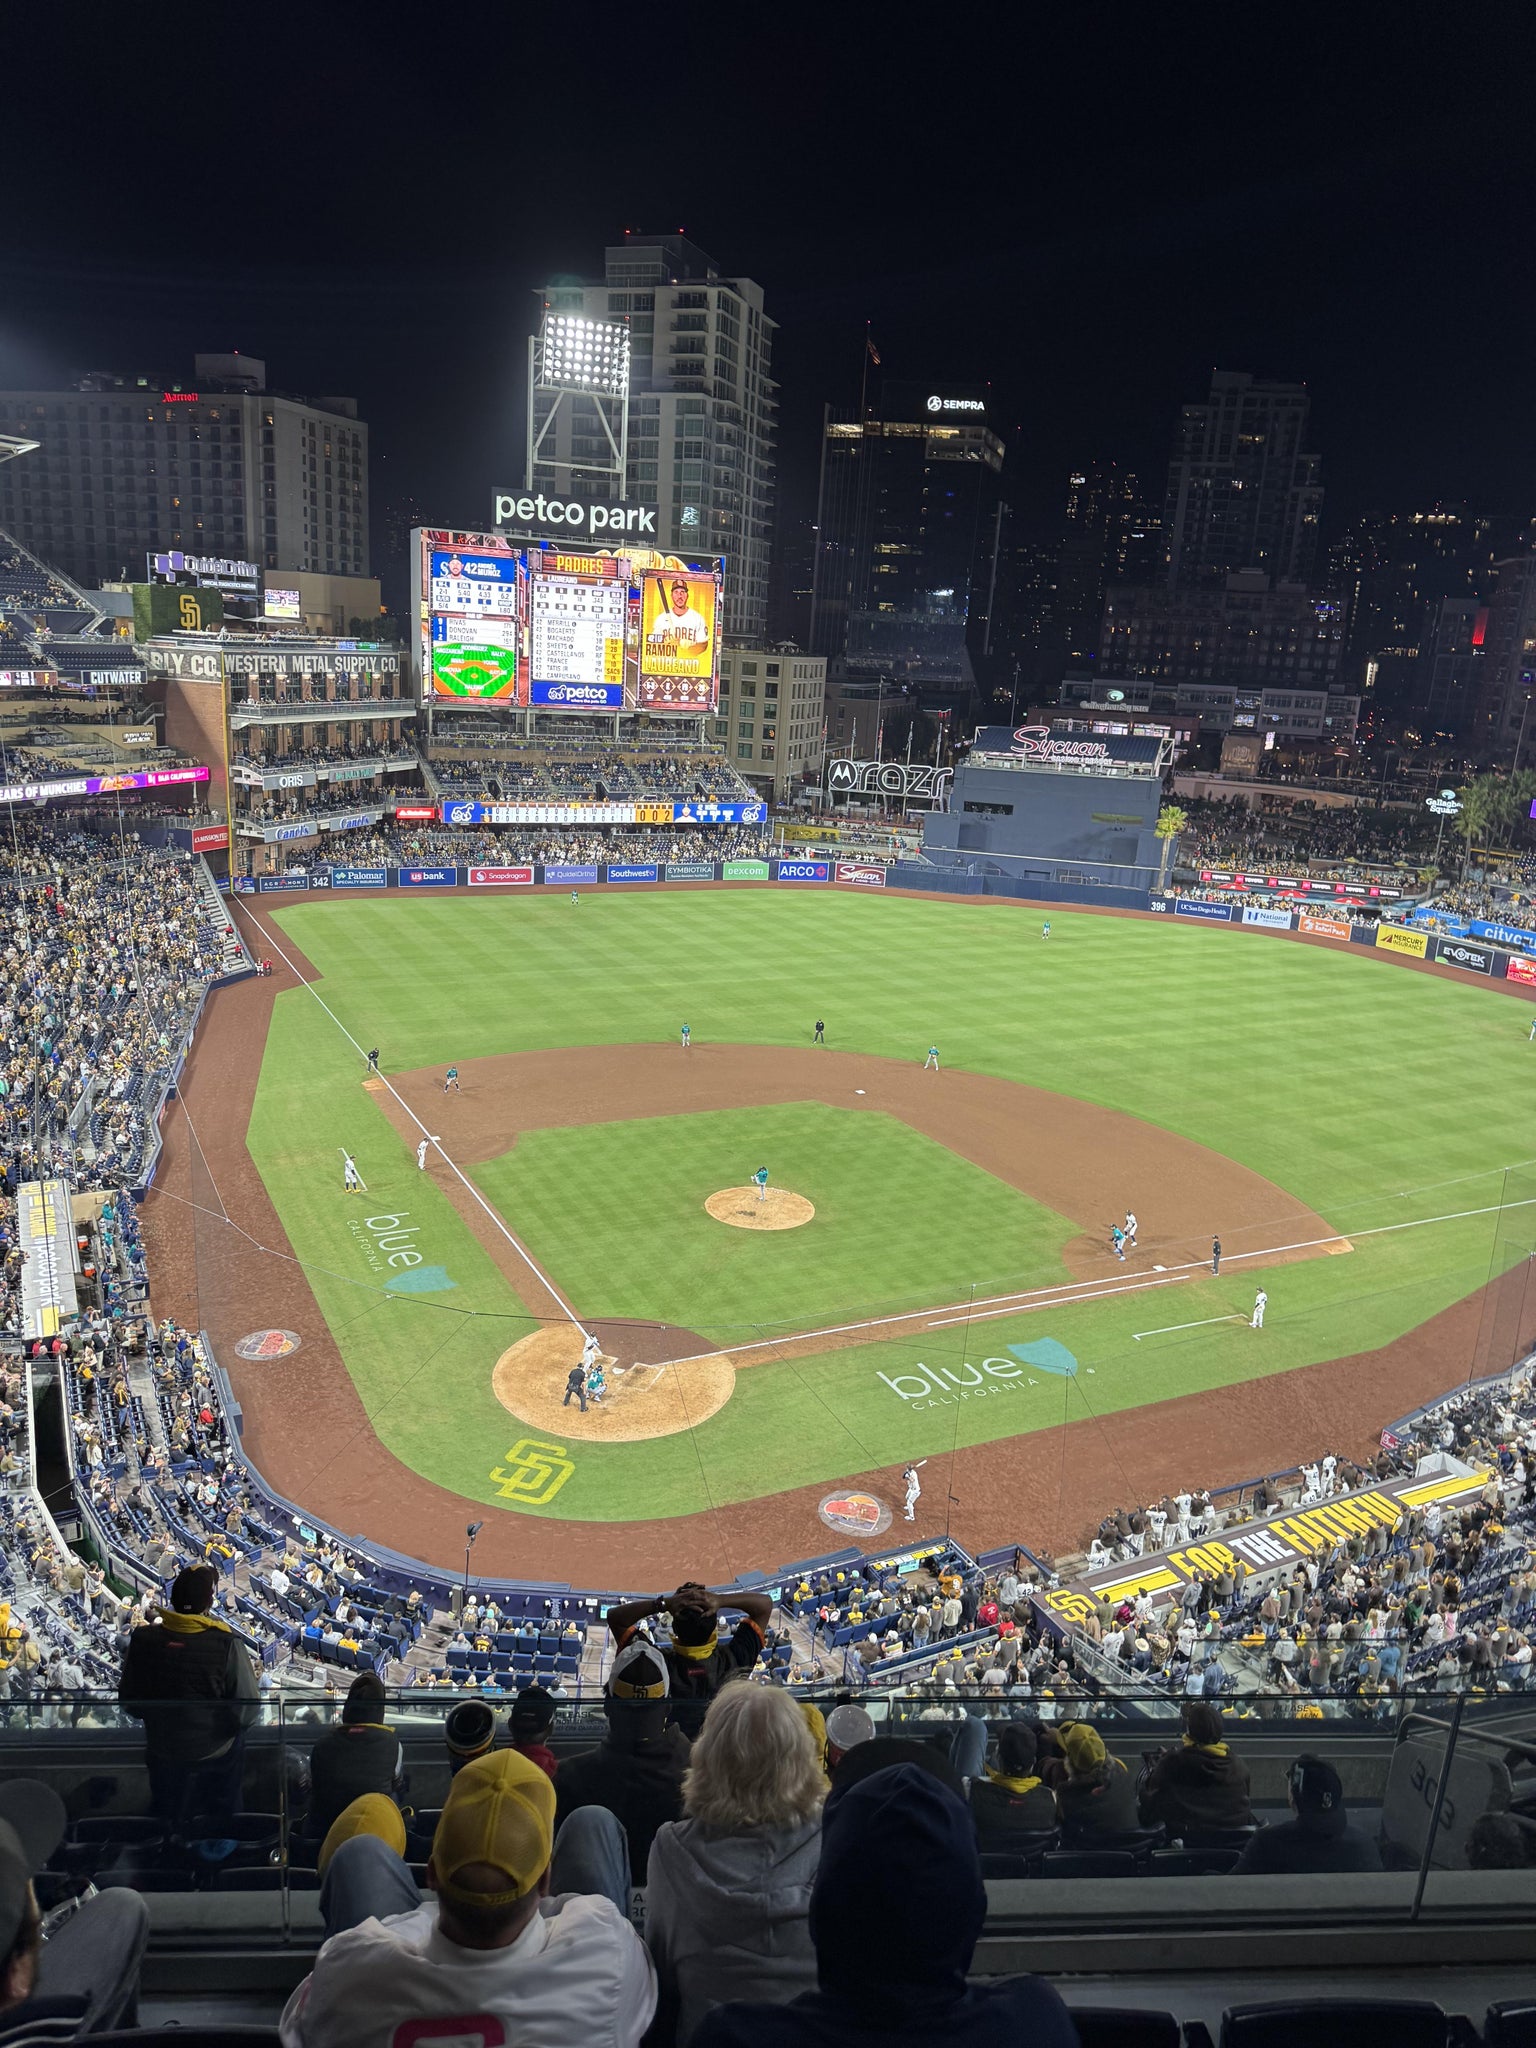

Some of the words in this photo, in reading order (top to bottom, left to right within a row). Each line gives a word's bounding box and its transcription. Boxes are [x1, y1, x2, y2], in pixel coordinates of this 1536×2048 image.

[943, 399, 985, 411] SEMPRA
[496, 494, 584, 524] petco
[590, 506, 656, 534] park
[464, 562, 478, 574] 42
[556, 555, 604, 574] PADRES
[646, 643, 678, 657] RAMÓN
[224, 654, 287, 673] WESTERN
[292, 655, 332, 672] METAL
[335, 656, 377, 672] SUPPLY
[381, 656, 399, 673] CO.
[645, 658, 700, 674] LAUREANO
[91, 672, 141, 684] CUTWATER
[566, 686, 607, 701] petco
[1011, 726, 1109, 761] Sycuan
[279, 776, 303, 788] ORIS
[860, 762, 954, 798] razr
[26, 784, 38, 798] OF
[40, 782, 87, 796] MUNCHIES
[640, 810, 645, 821] 0
[652, 810, 658, 821] 0
[665, 810, 670, 821] 2
[348, 872, 384, 880] Palomar
[423, 872, 445, 880] bank
[488, 872, 527, 881] Snapdragon
[557, 870, 595, 878] QuidelOrtho
[610, 870, 650, 878] Southwest
[780, 866, 814, 876] ARCO
[838, 866, 880, 884] Sycuan
[312, 877, 329, 887] 342
[1151, 902, 1166, 911] 396
[1260, 912, 1288, 922] National
[1393, 939, 1423, 952] INSURANCE
[1394, 934, 1424, 946] MERCURY
[347, 1219, 385, 1272] CALIFORNIA
[364, 1212, 423, 1268] blue
[34, 1278, 61, 1306] park
[876, 1357, 1023, 1400] blue
[912, 1377, 1039, 1410] CALIFORNIA
[1227, 1529, 1296, 1566] THE
